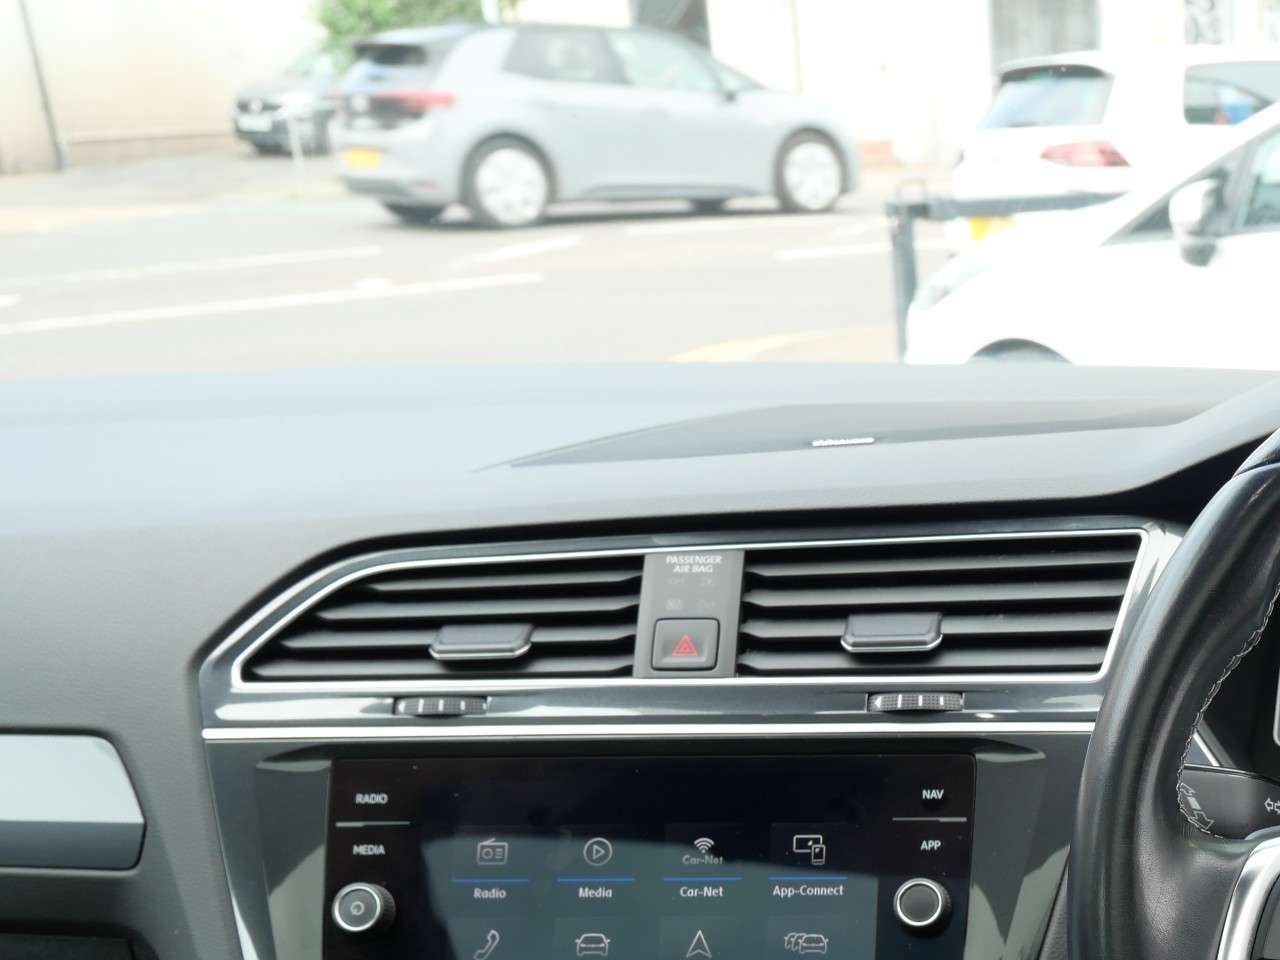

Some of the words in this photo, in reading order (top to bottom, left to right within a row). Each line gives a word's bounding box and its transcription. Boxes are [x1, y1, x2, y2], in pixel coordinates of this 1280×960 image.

[666, 555, 722, 564] PASSENGER
[673, 565, 690, 573] AIR
[692, 565, 713, 573] BAG
[355, 792, 388, 804] RADIO
[921, 788, 944, 800] NAV
[352, 844, 386, 856] MEDIA
[920, 840, 941, 851] APP
[472, 886, 507, 900] Radio
[578, 886, 613, 899] Media
[679, 885, 724, 898] Car-Net
[772, 883, 845, 898] App-Connect
